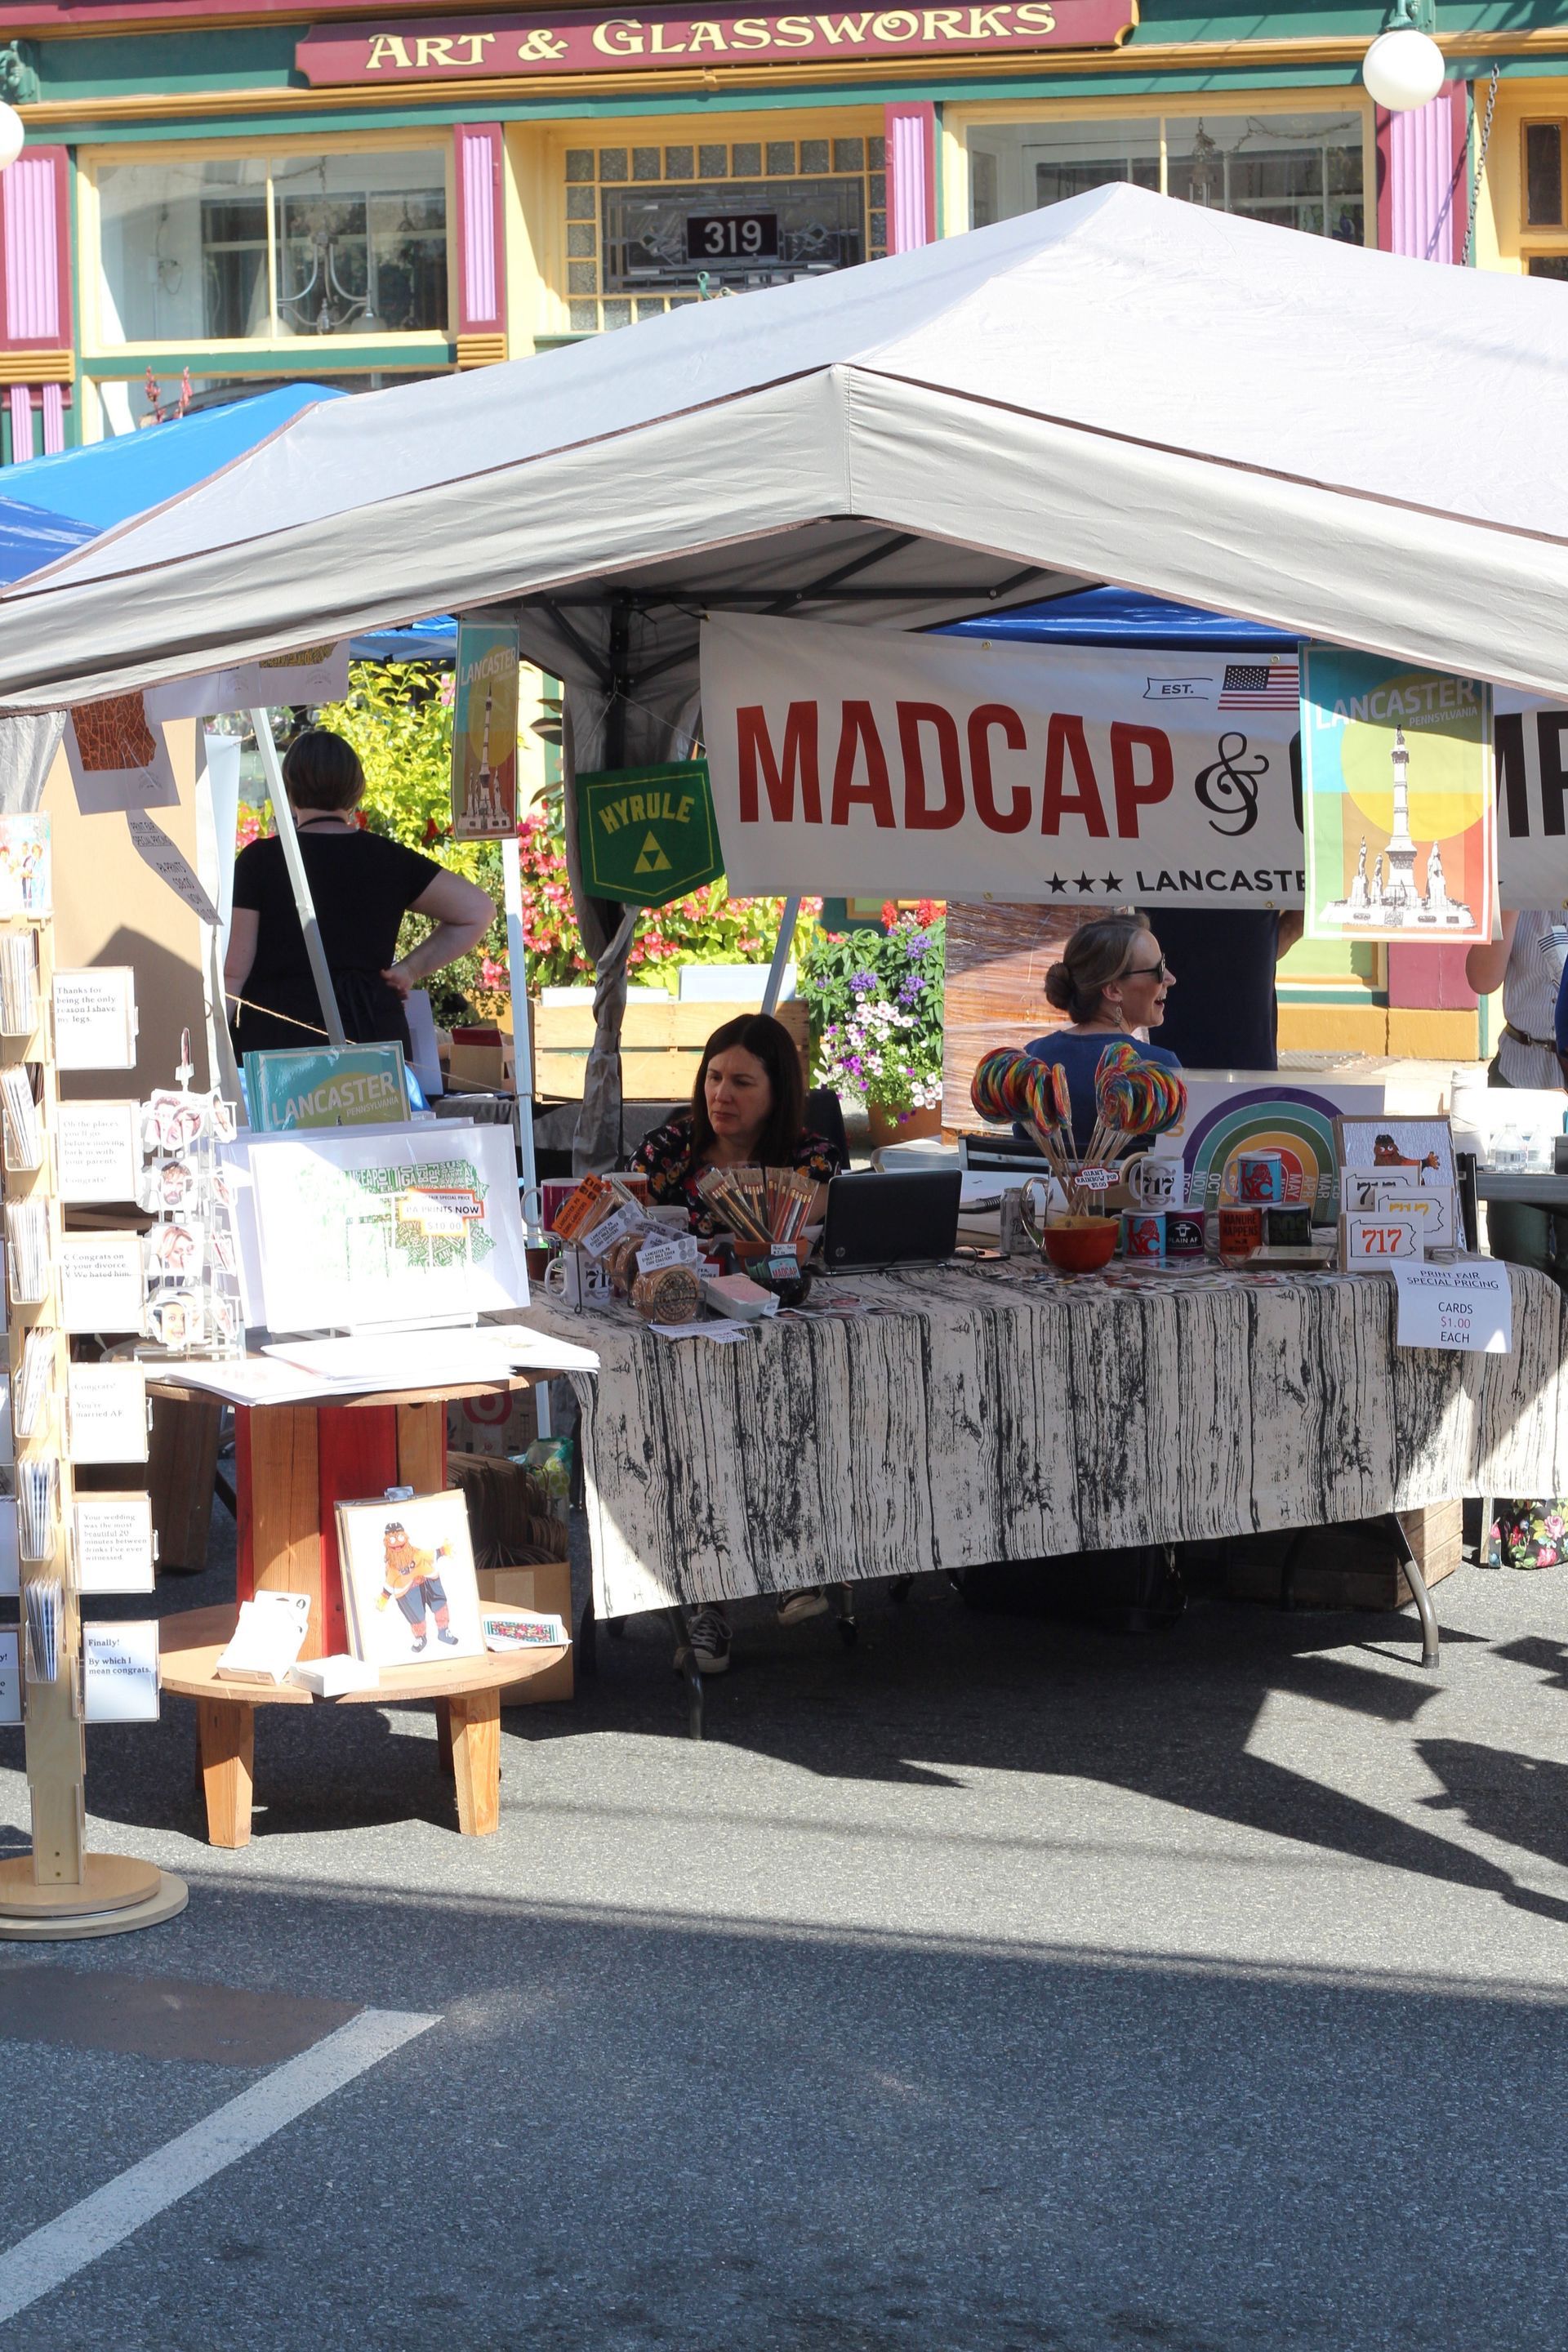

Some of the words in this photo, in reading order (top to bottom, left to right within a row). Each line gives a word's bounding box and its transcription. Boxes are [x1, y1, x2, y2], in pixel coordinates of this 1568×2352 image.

[517, 29, 569, 61] &
[592, 3, 1057, 56] GLASSWORKS
[705, 220, 762, 253] 319
[461, 647, 516, 686] LANCASTER
[1161, 684, 1194, 695] EST.
[1316, 678, 1475, 730] LANCASTER
[1409, 707, 1477, 728] PENNSYLVANIA
[736, 700, 1174, 839] MADCAP
[1194, 731, 1269, 836] &
[598, 792, 694, 835] HYRULE
[56, 987, 87, 995] Thanks
[56, 996, 79, 1005] being
[97, 996, 116, 1004] only
[271, 1071, 396, 1125] LANCASTER
[346, 1095, 399, 1117] PENNSYLVANIA
[1143, 1176, 1175, 1196] 717
[1192, 1170, 1207, 1196] NOV
[1207, 1173, 1222, 1196] OCT
[1287, 1174, 1303, 1197] MAY
[1302, 1176, 1316, 1198] APR
[1317, 1174, 1332, 1199] MAR
[421, 1205, 453, 1214] PRINTS
[455, 1205, 479, 1214] NOW
[1223, 1214, 1256, 1224] MANURE
[1223, 1225, 1258, 1236] HAPPENS
[1362, 1229, 1402, 1253] 717
[1406, 1277, 1453, 1286] SPECIAL
[1454, 1280, 1499, 1289] PRICING
[1420, 1271, 1452, 1279] PRINT
[1456, 1272, 1480, 1280] FAIR
[1438, 1302, 1473, 1314] CARDS
[1441, 1316, 1471, 1329] $1.00
[1441, 1332, 1470, 1343] EACH
[104, 1513, 136, 1521] wedding
[88, 1639, 120, 1648] Finally!
[88, 1659, 100, 1668] By
[102, 1657, 127, 1665] which
[113, 1666, 151, 1676] congrats.
